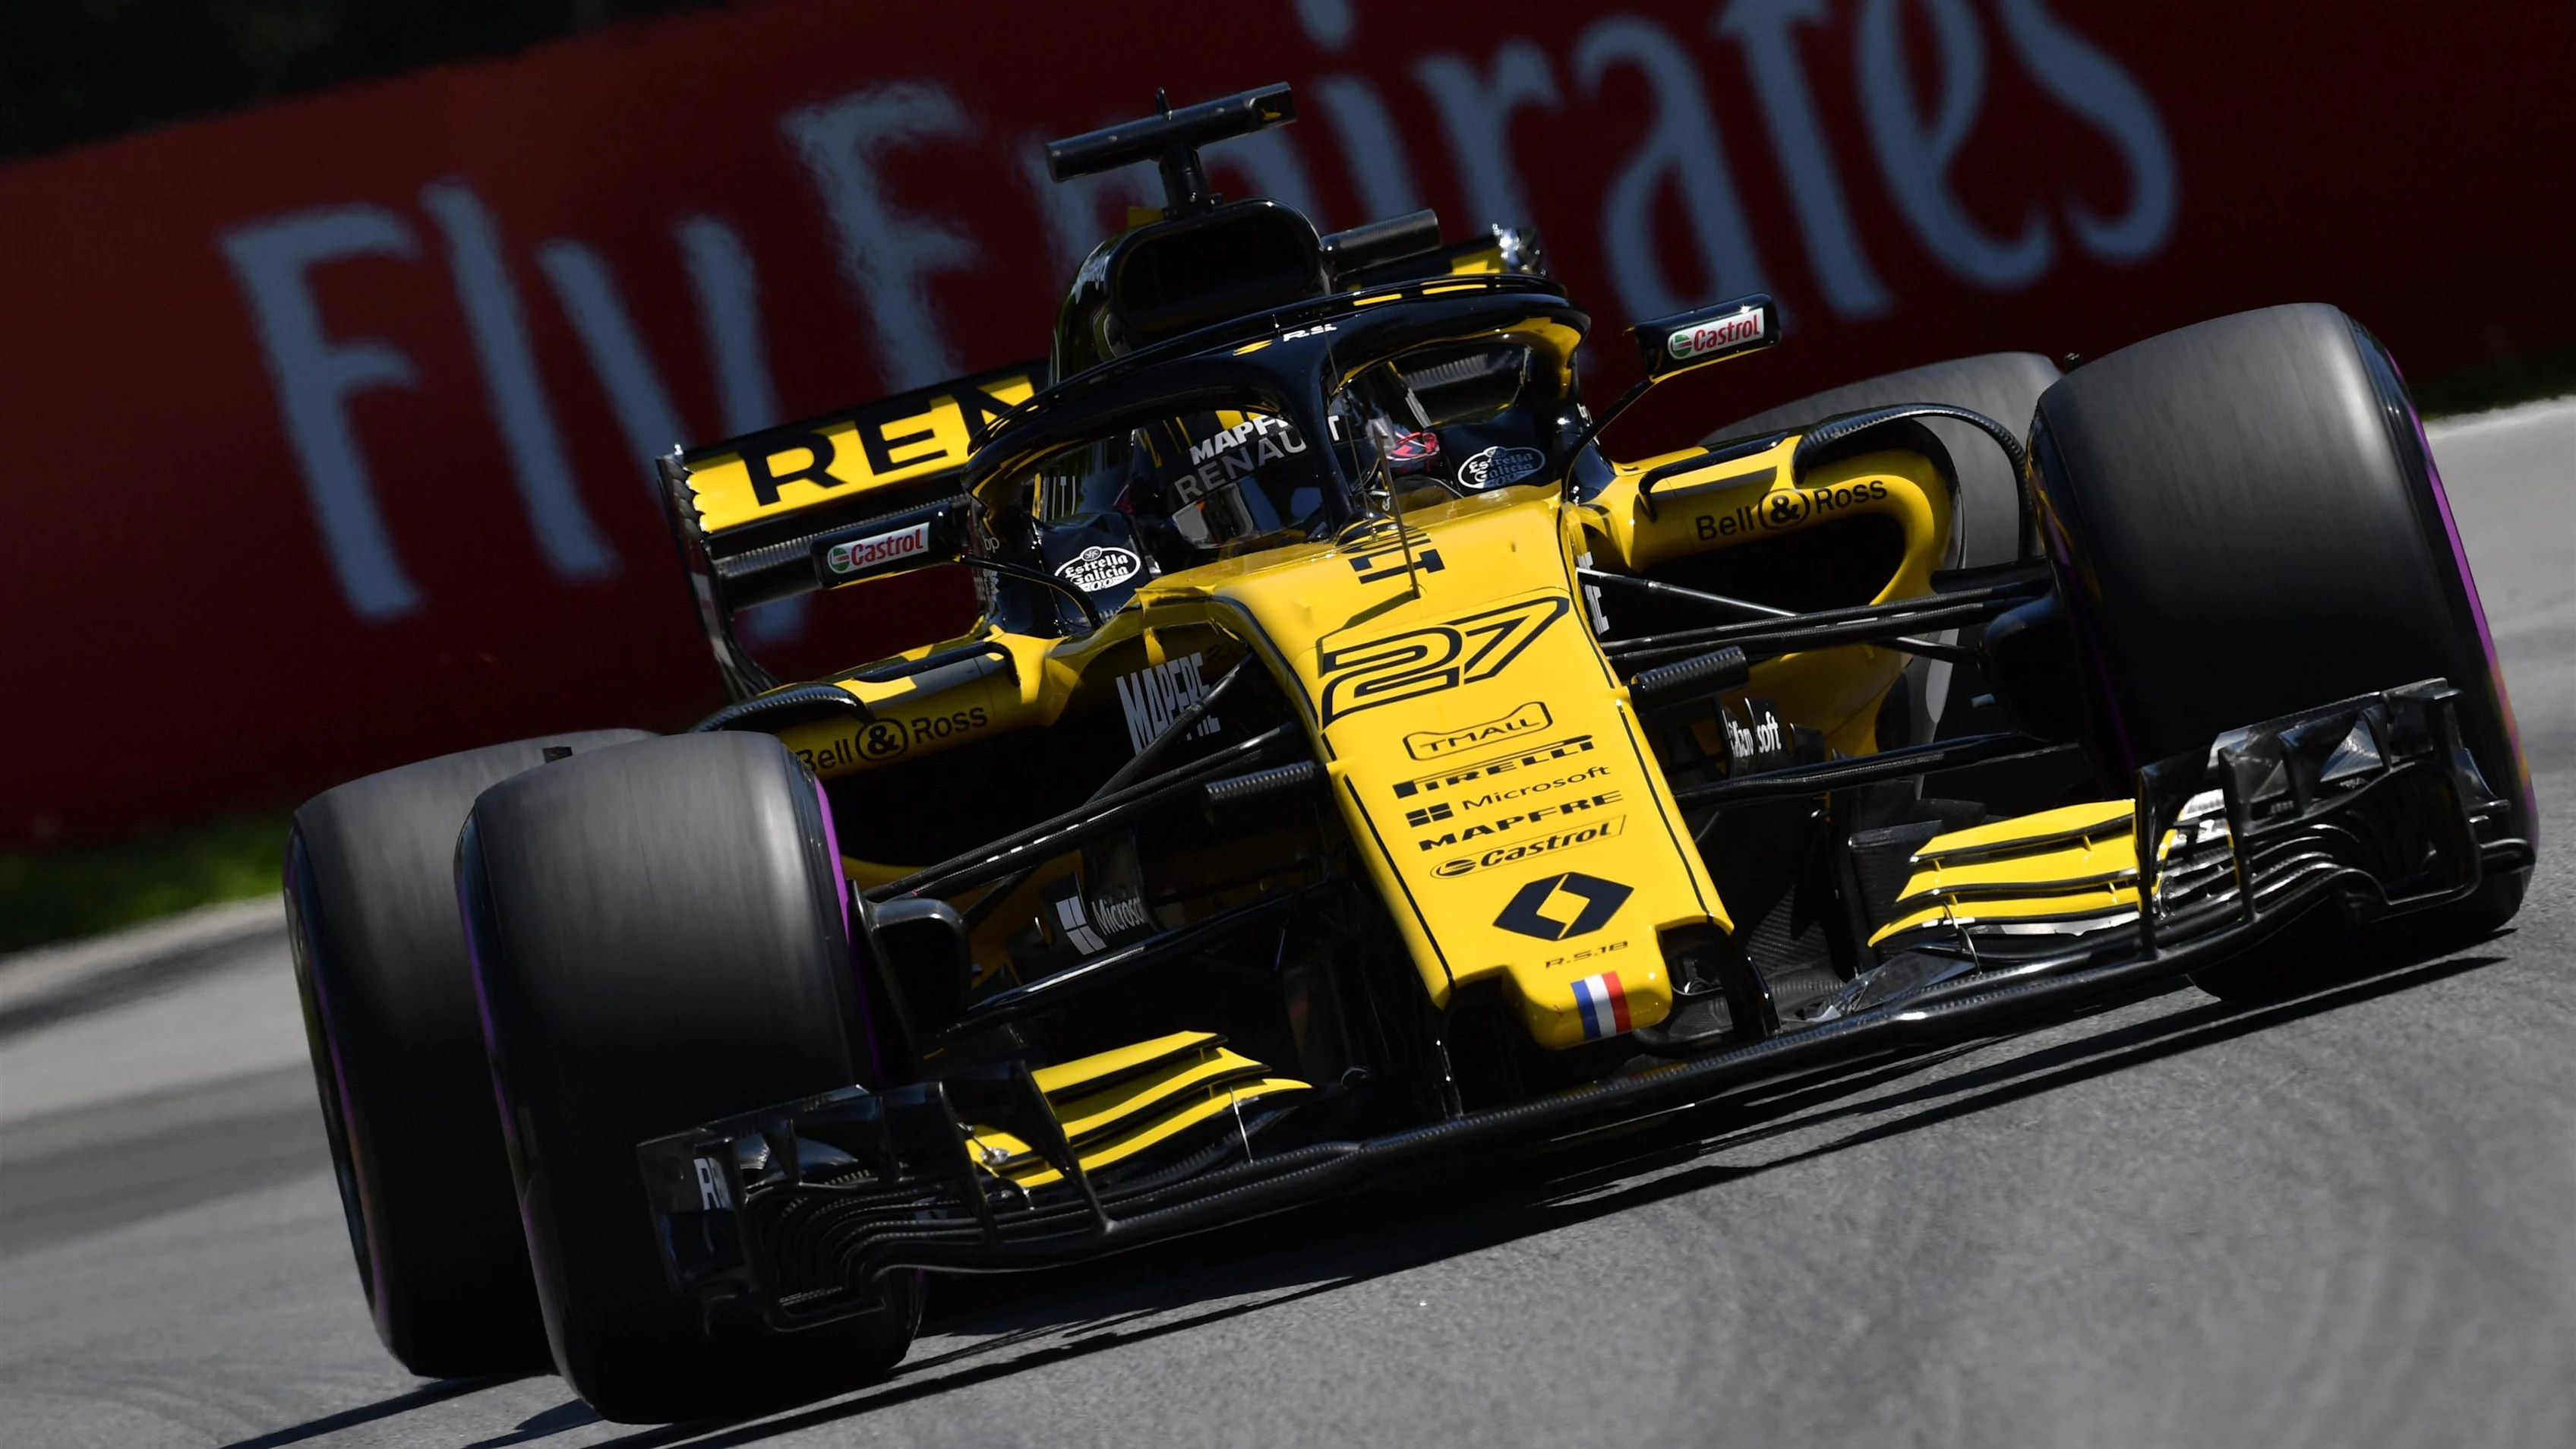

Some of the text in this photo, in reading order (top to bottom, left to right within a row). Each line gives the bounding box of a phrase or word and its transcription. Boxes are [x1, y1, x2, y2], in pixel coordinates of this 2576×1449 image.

[1694, 314, 1760, 352] Castrol
[219, 176, 816, 644] Fly
[1469, 453, 1533, 473] Estrella
[1695, 506, 1754, 541] Bell
[1813, 480, 1887, 514] Ross
[851, 529, 923, 567] Castrol
[1065, 554, 1129, 579] Estrella
[1070, 566, 1129, 586] Galicia
[1321, 596, 1570, 731] 27
[911, 707, 987, 743] Ross
[1419, 718, 1540, 752] TMALL
[1392, 734, 1595, 799] PIRELLI
[1462, 766, 1611, 810] Microsoft
[1419, 791, 1623, 852] MAPFRE
[1481, 822, 1612, 867] Castrol
[1091, 897, 1144, 936] Microso
